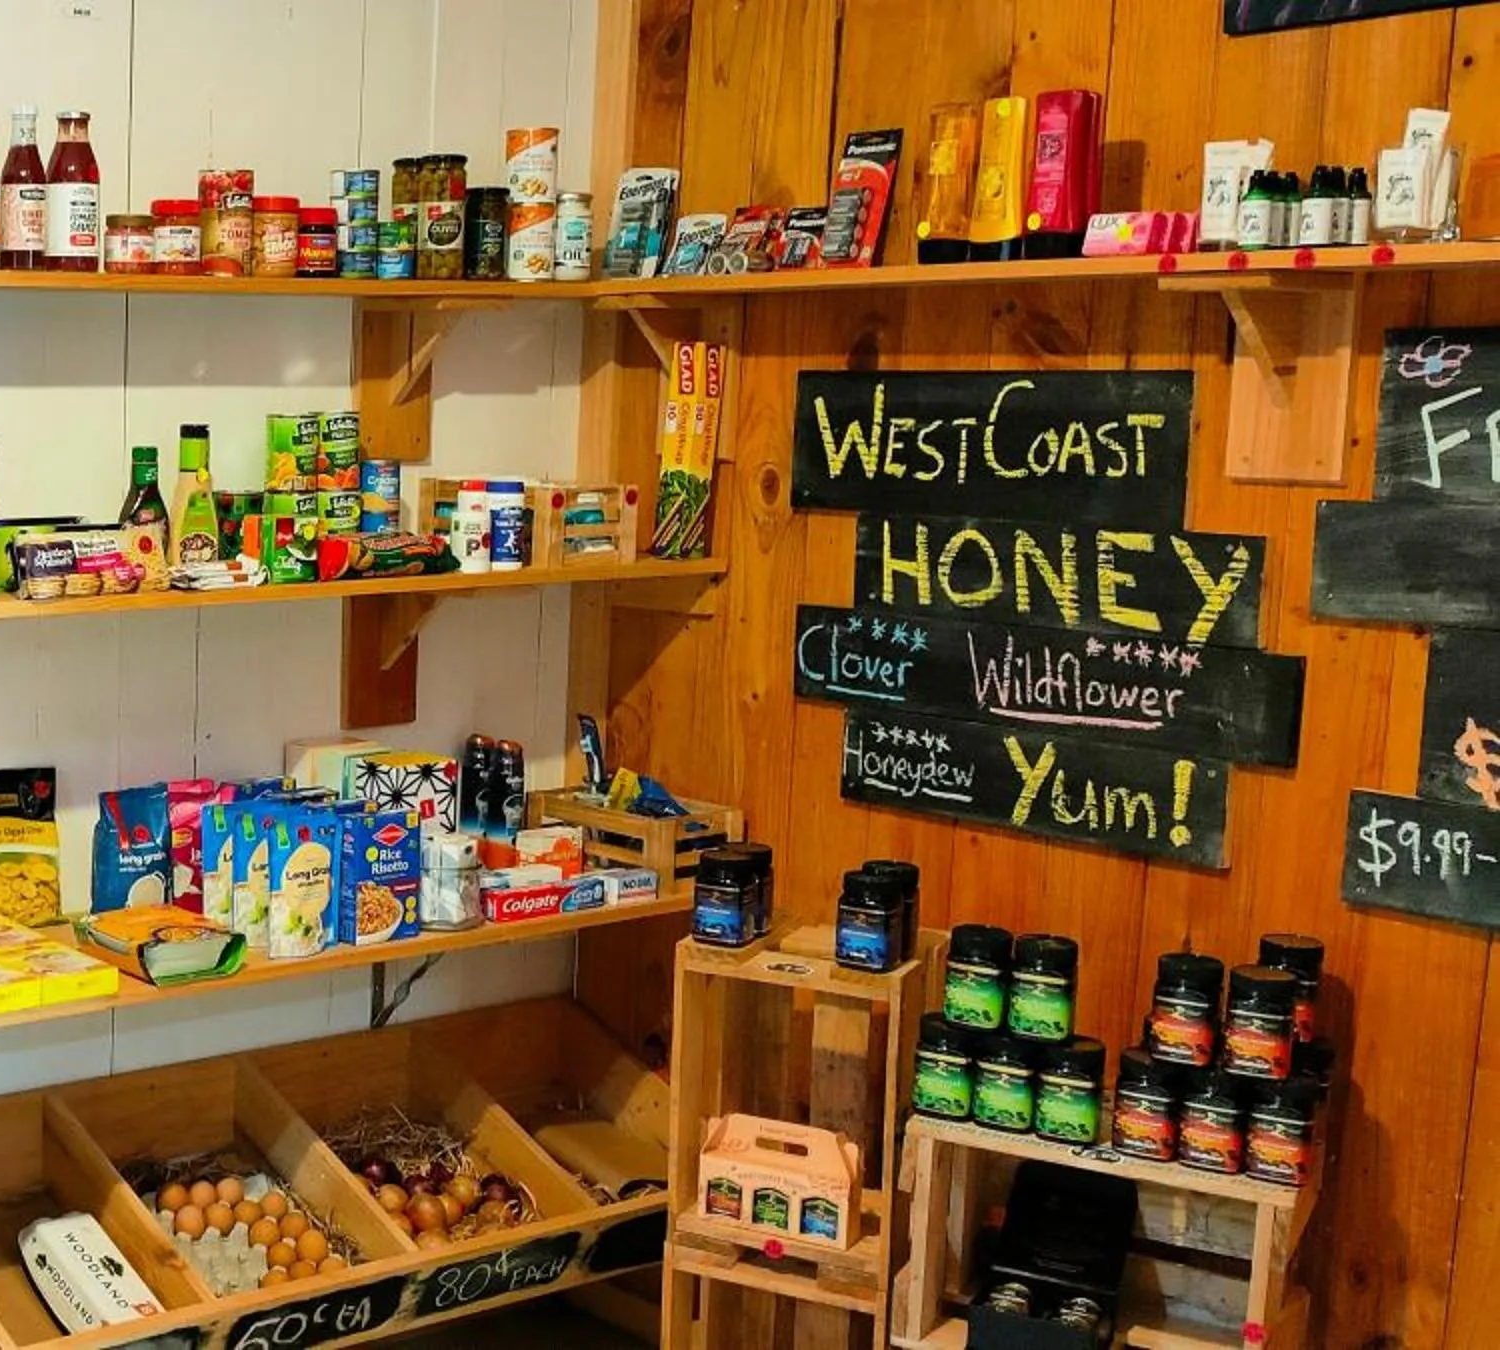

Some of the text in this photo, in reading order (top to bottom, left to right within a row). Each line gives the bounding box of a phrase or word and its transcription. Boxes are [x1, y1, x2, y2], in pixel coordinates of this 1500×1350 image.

[680, 344, 693, 394] GLAD
[707, 346, 720, 397] GLAD
[881, 519, 1252, 650] HONEY
[798, 622, 1186, 718] Clover Wildflower
[843, 725, 1197, 849] Honeydew Yum!
[286, 866, 330, 882] Long Grai
[371, 859, 410, 876] Risotto
[379, 849, 403, 861] Rice
[502, 893, 560, 914] Colgate
[46, 1265, 94, 1326] WOODLAND
[63, 1231, 132, 1310] WOODLAND
[509, 1256, 569, 1290] EACH
